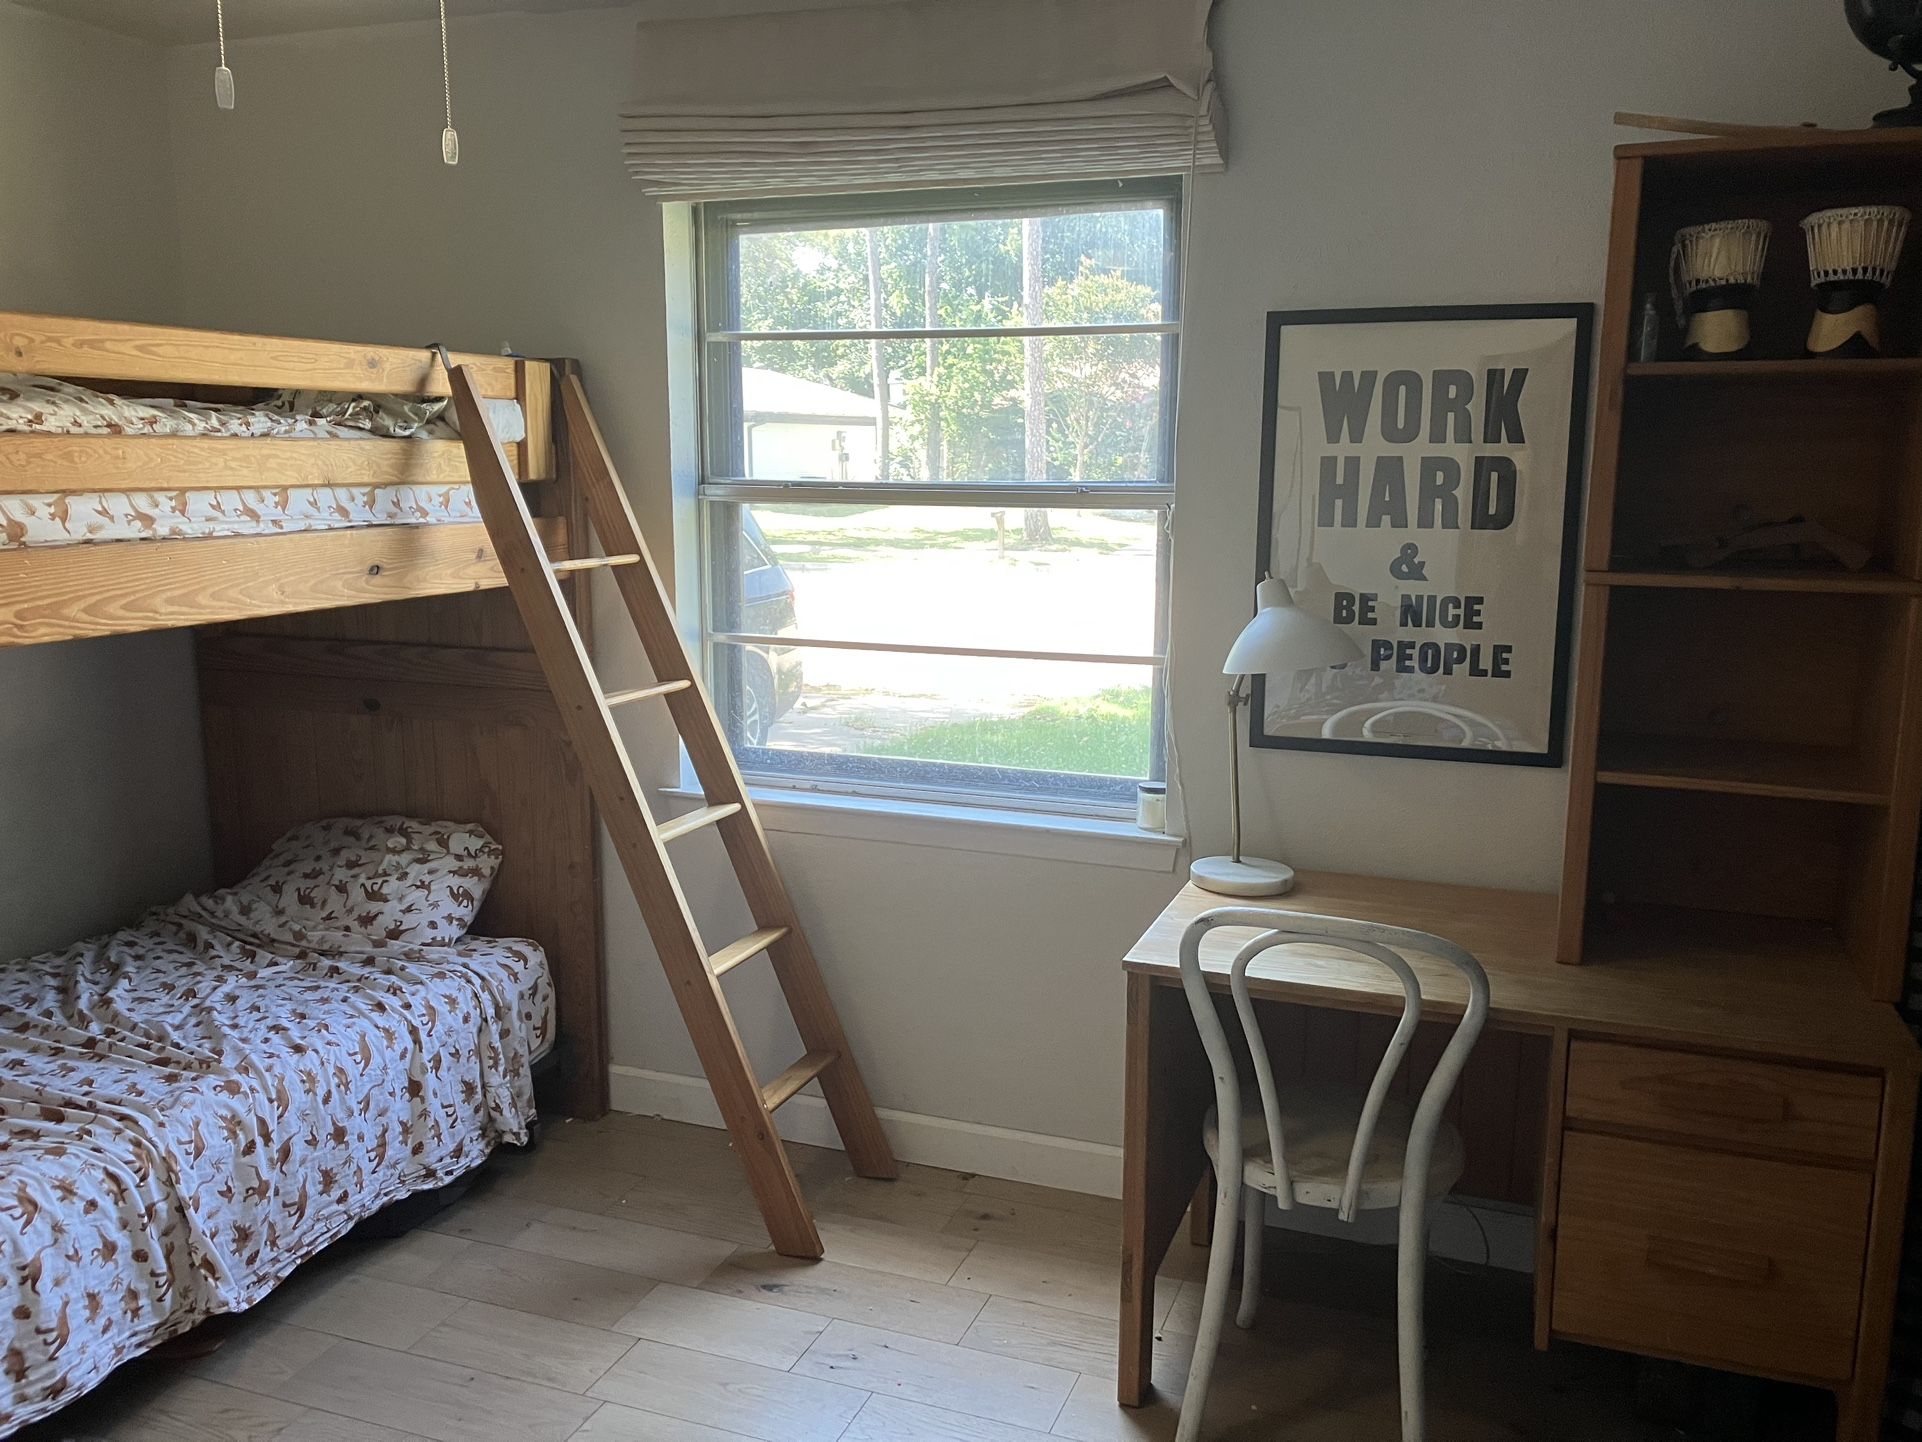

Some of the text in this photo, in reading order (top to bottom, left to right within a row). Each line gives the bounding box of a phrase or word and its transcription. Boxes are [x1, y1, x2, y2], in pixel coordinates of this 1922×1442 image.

[1317, 368, 1529, 444] WORK
[1317, 455, 1517, 531] HARD
[1389, 542, 1428, 581] &
[1333, 592, 1484, 630] BE NICE
[1370, 639, 1512, 679] PEOPLE
